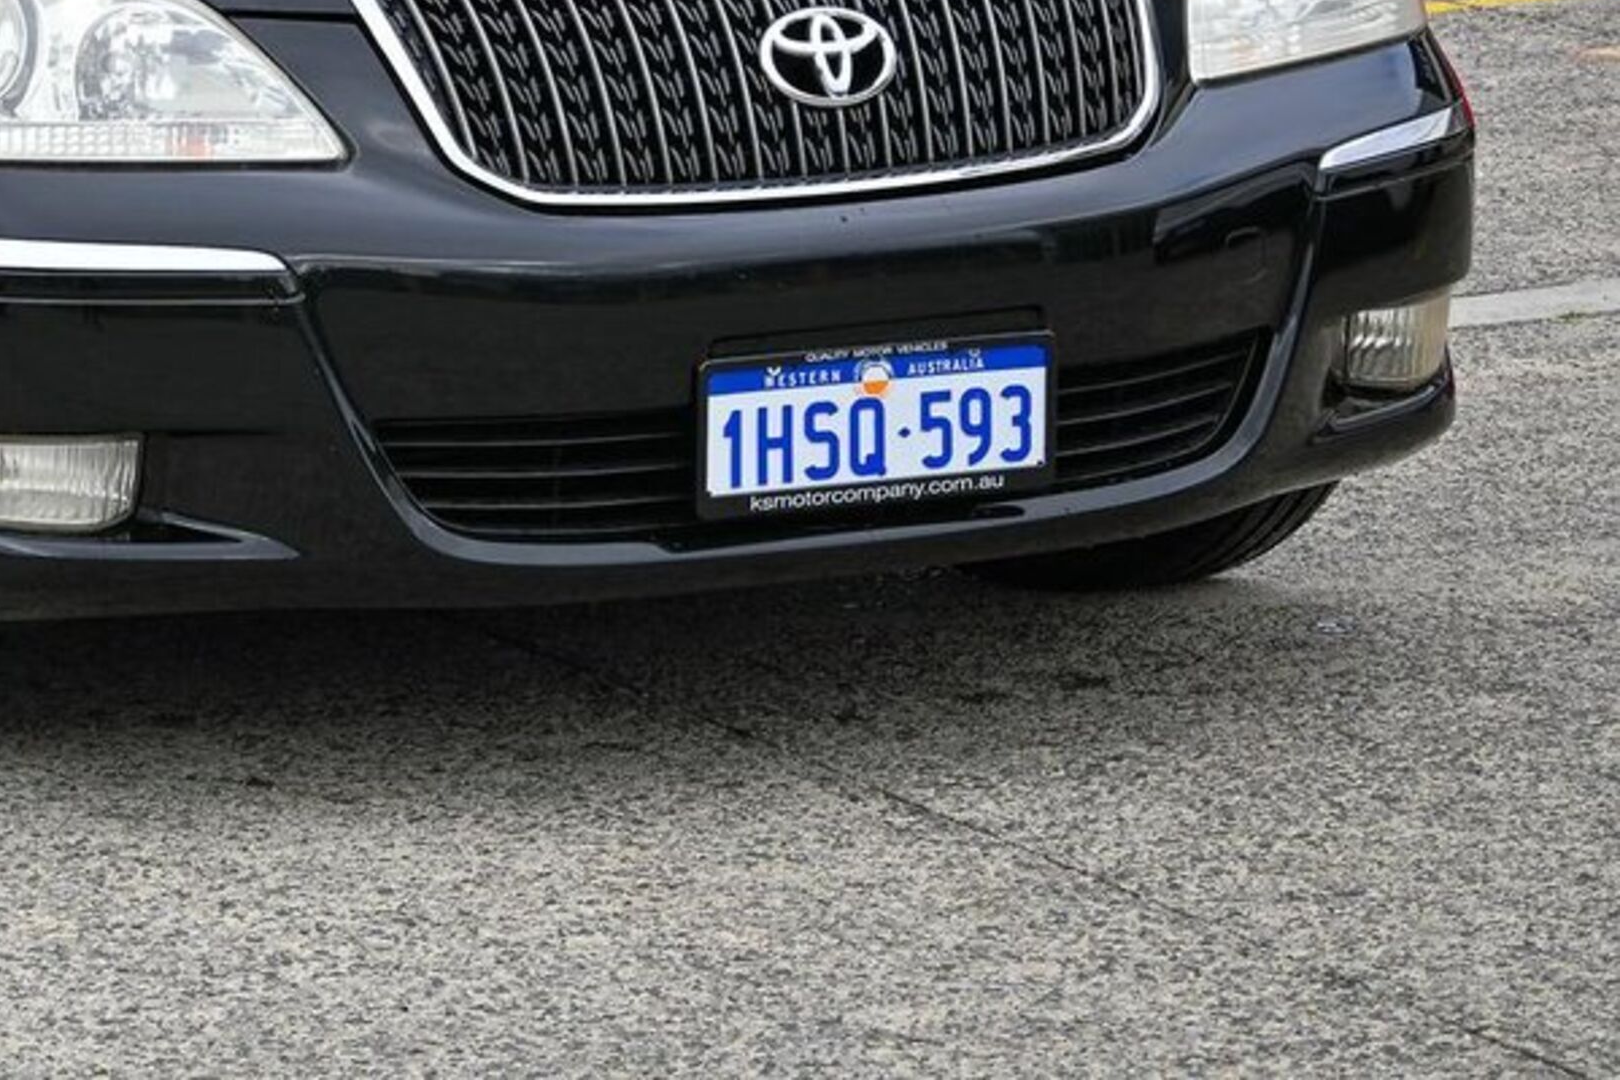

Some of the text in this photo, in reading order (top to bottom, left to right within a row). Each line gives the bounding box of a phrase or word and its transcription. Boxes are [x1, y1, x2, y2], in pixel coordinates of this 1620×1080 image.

[853, 346, 892, 359] MOTOR
[896, 340, 948, 354] VEHICLES
[907, 357, 985, 376] AUSTRALIA
[749, 473, 1005, 514] ksmotorcompany.com.au
